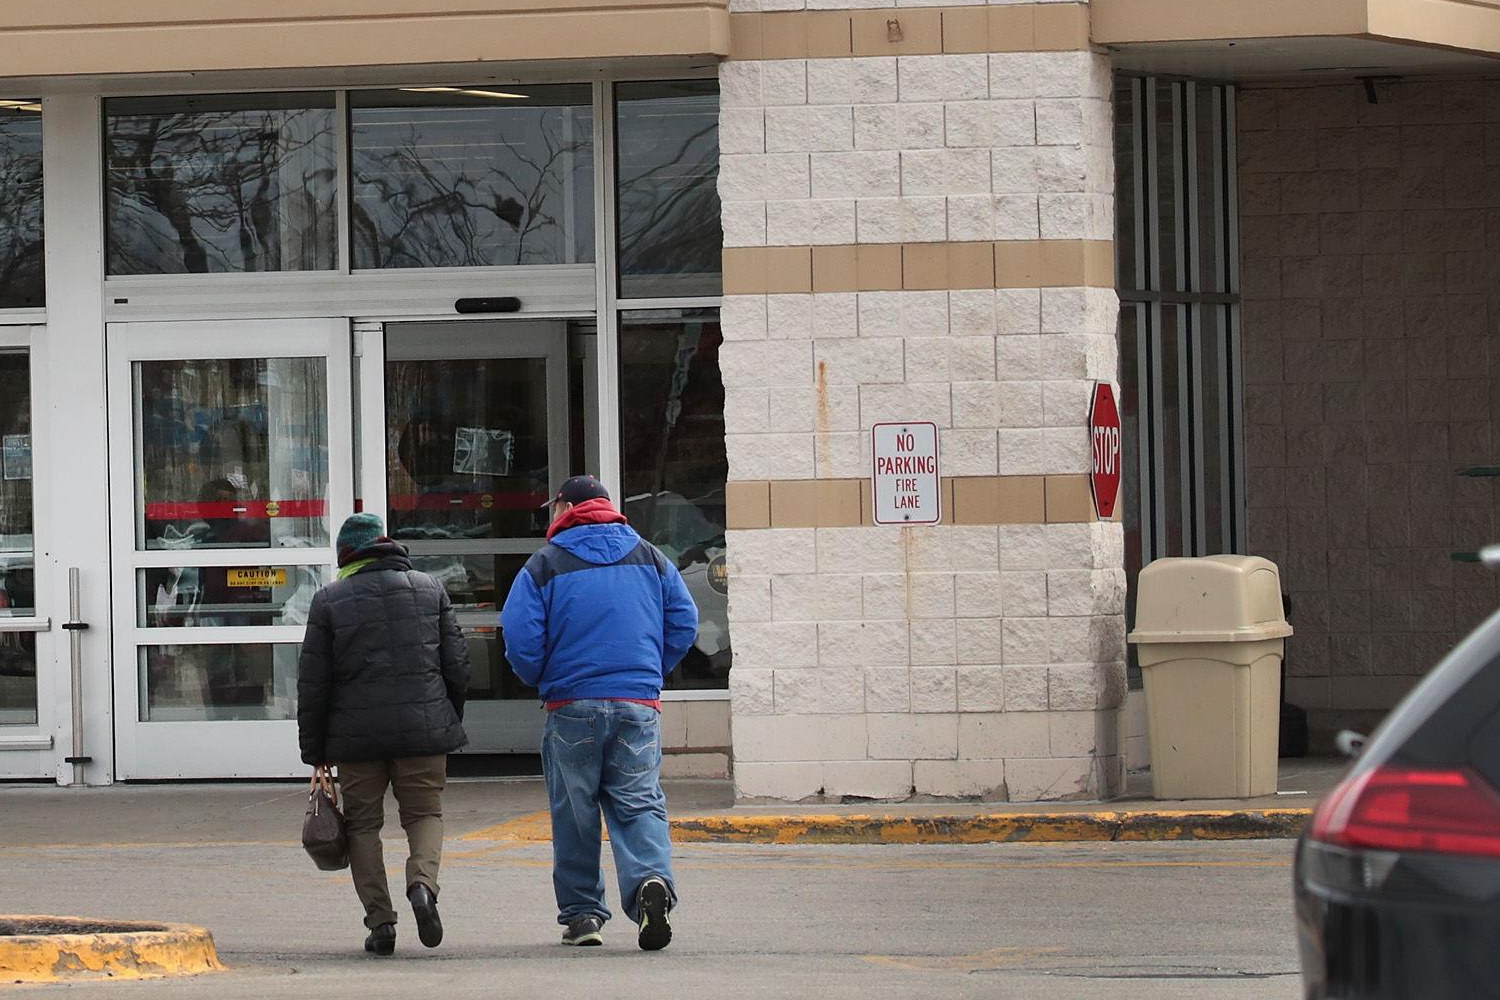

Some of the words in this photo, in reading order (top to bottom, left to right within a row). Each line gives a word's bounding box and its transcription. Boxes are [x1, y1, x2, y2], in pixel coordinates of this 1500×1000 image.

[896, 433, 915, 452] NO
[1093, 425, 1119, 475] STOP
[877, 455, 935, 475] PARKING
[895, 478, 918, 492] FIRE
[894, 495, 920, 509] LANE
[237, 570, 277, 578] CAUTION
